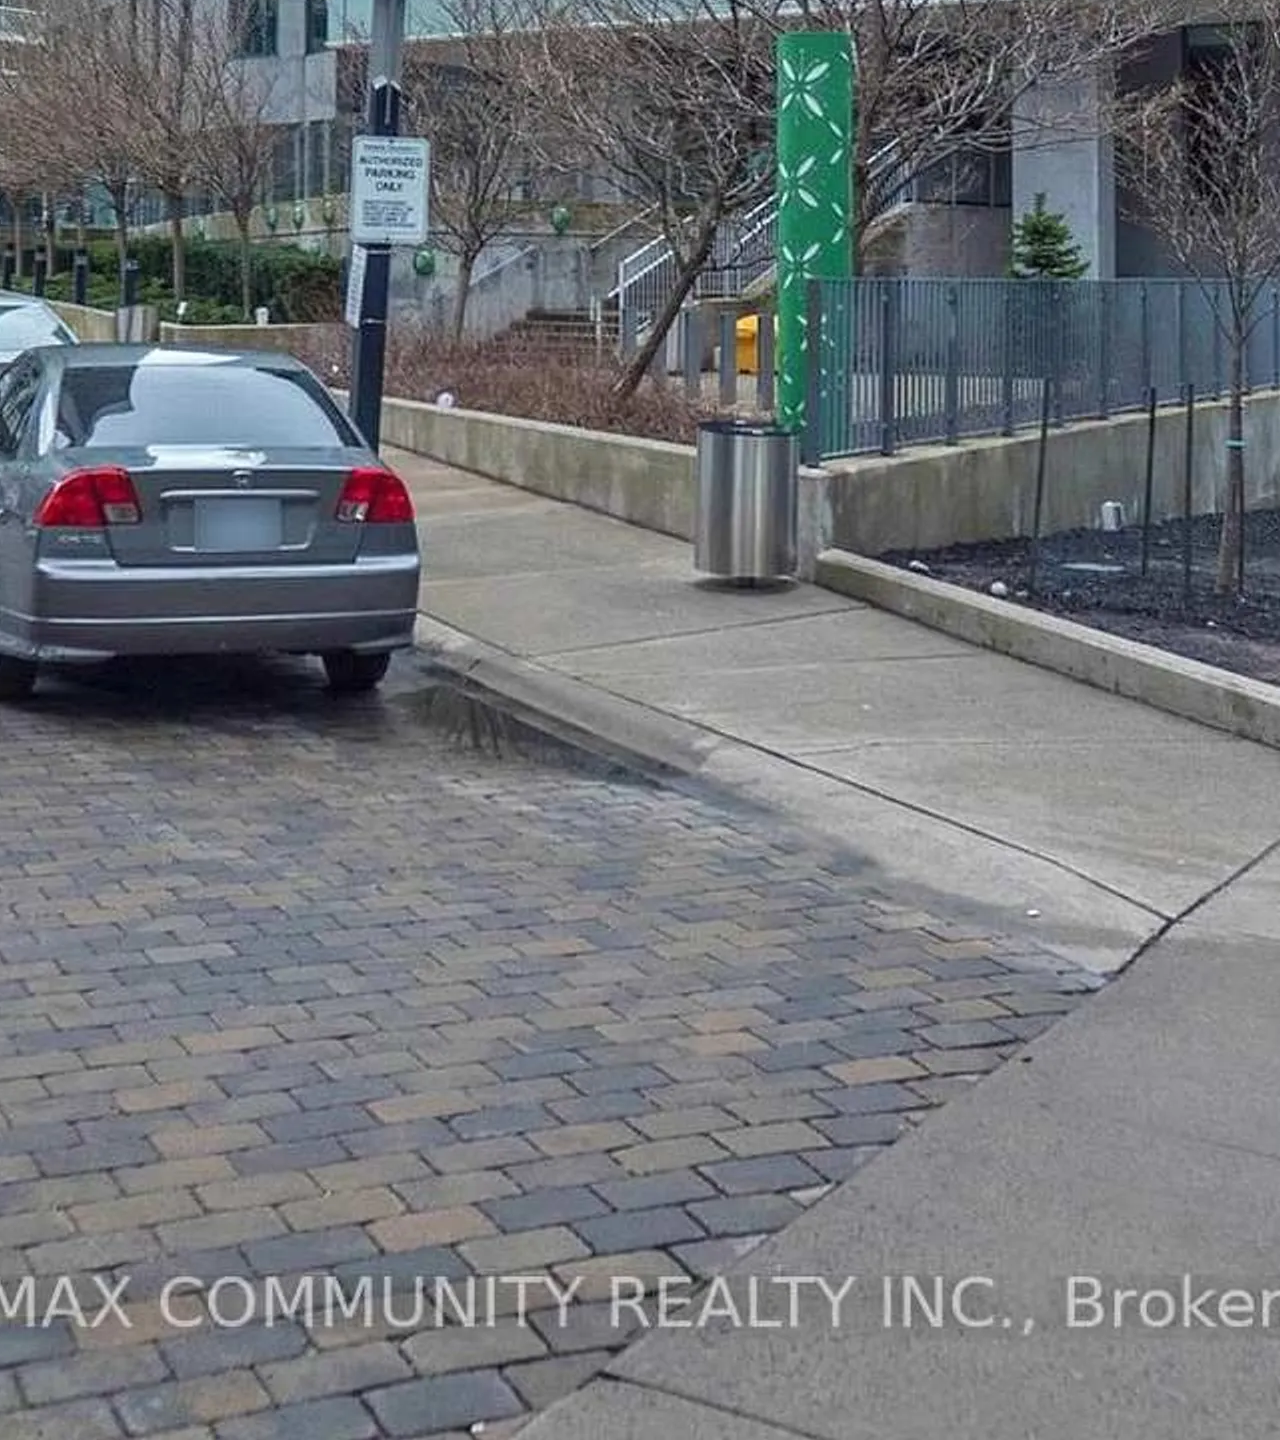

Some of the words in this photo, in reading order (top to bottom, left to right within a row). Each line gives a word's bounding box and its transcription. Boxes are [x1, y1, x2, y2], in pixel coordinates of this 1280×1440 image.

[360, 156, 423, 168] AUTHORIZED
[365, 167, 415, 180] PARKING
[375, 181, 402, 192] ONLY
